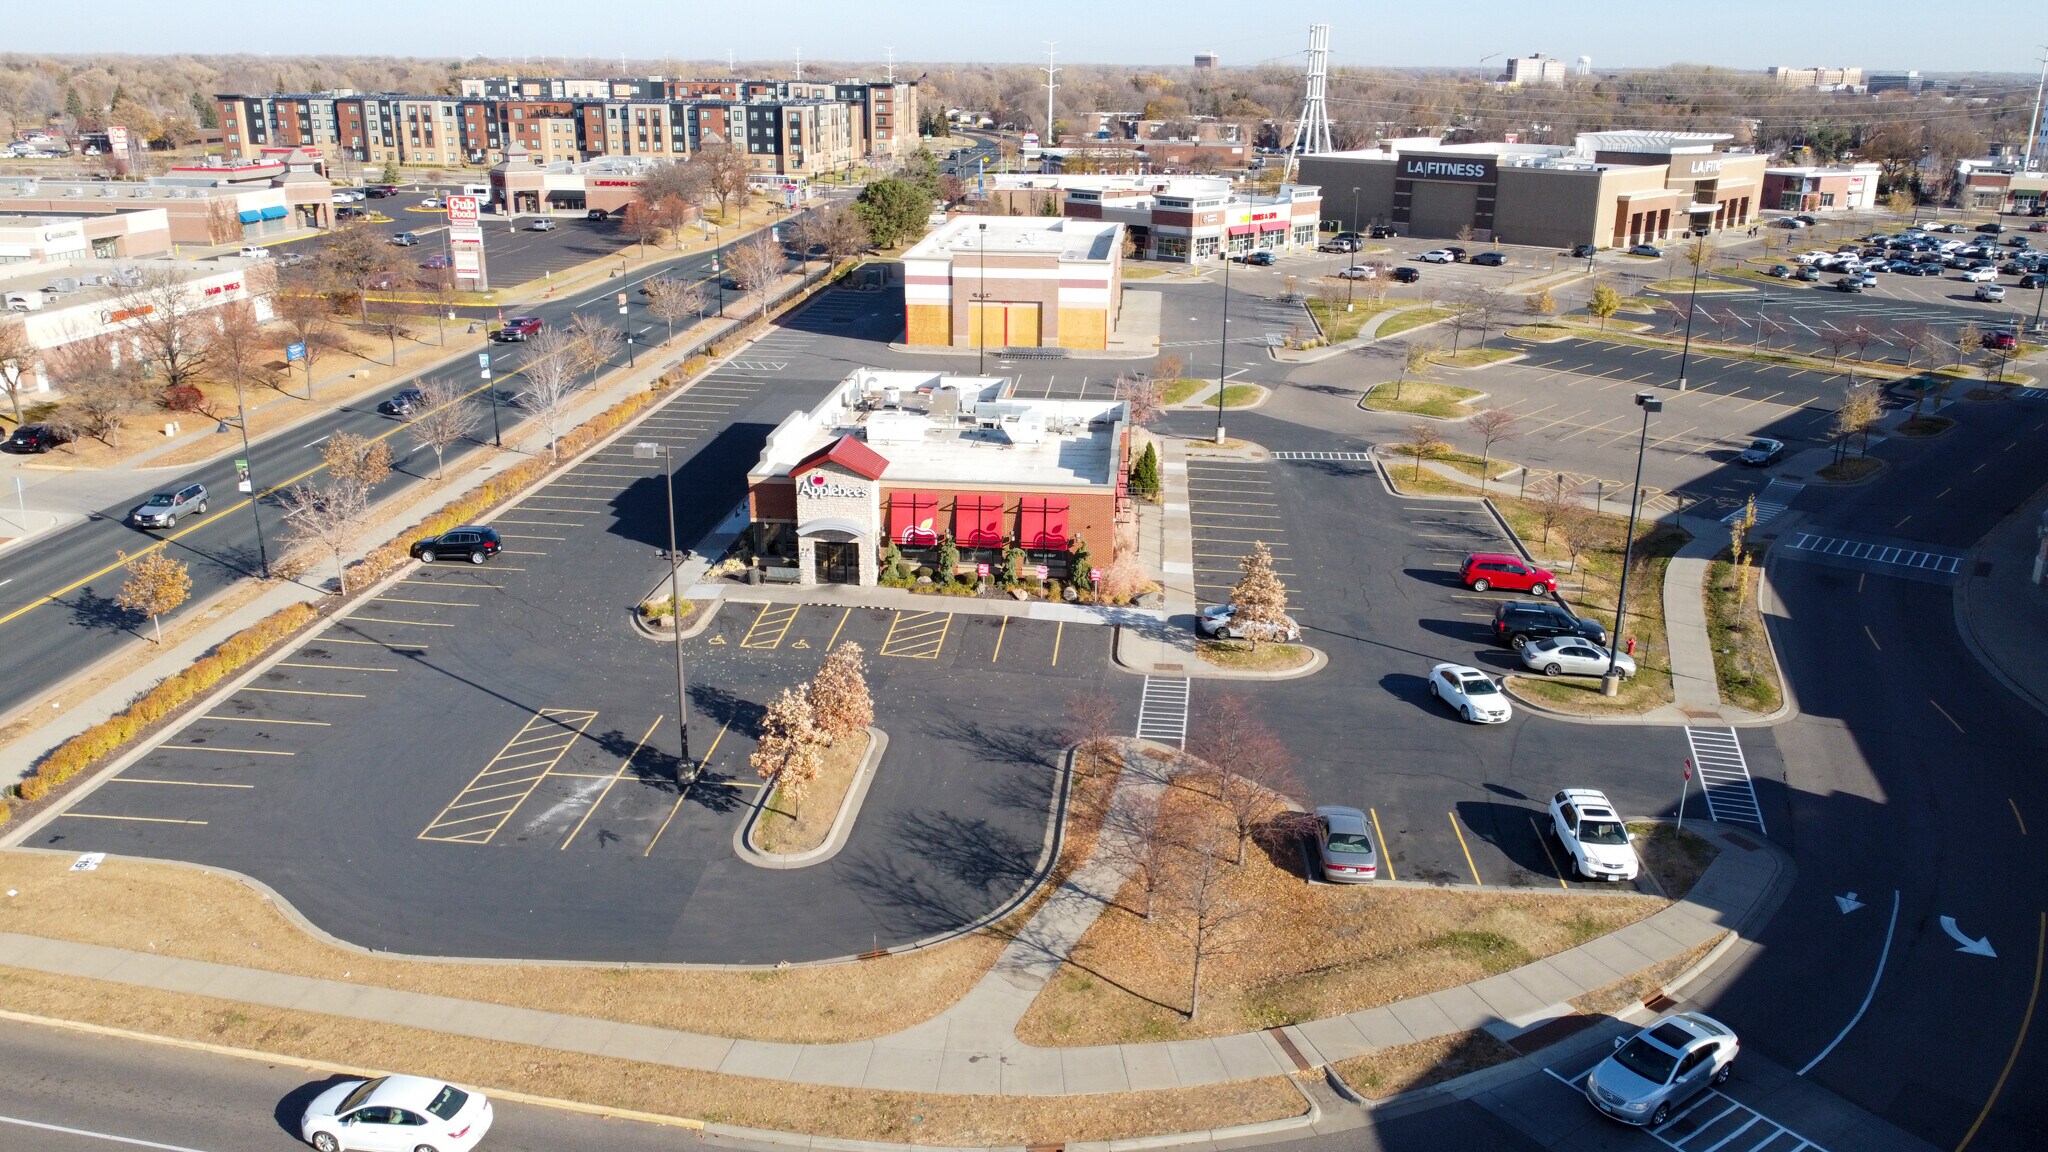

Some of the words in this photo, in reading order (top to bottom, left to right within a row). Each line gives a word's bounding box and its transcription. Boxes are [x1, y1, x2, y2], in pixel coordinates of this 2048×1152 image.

[1427, 161, 1485, 177] FITNESS
[449, 197, 476, 210] Cub
[450, 209, 476, 219] Foods
